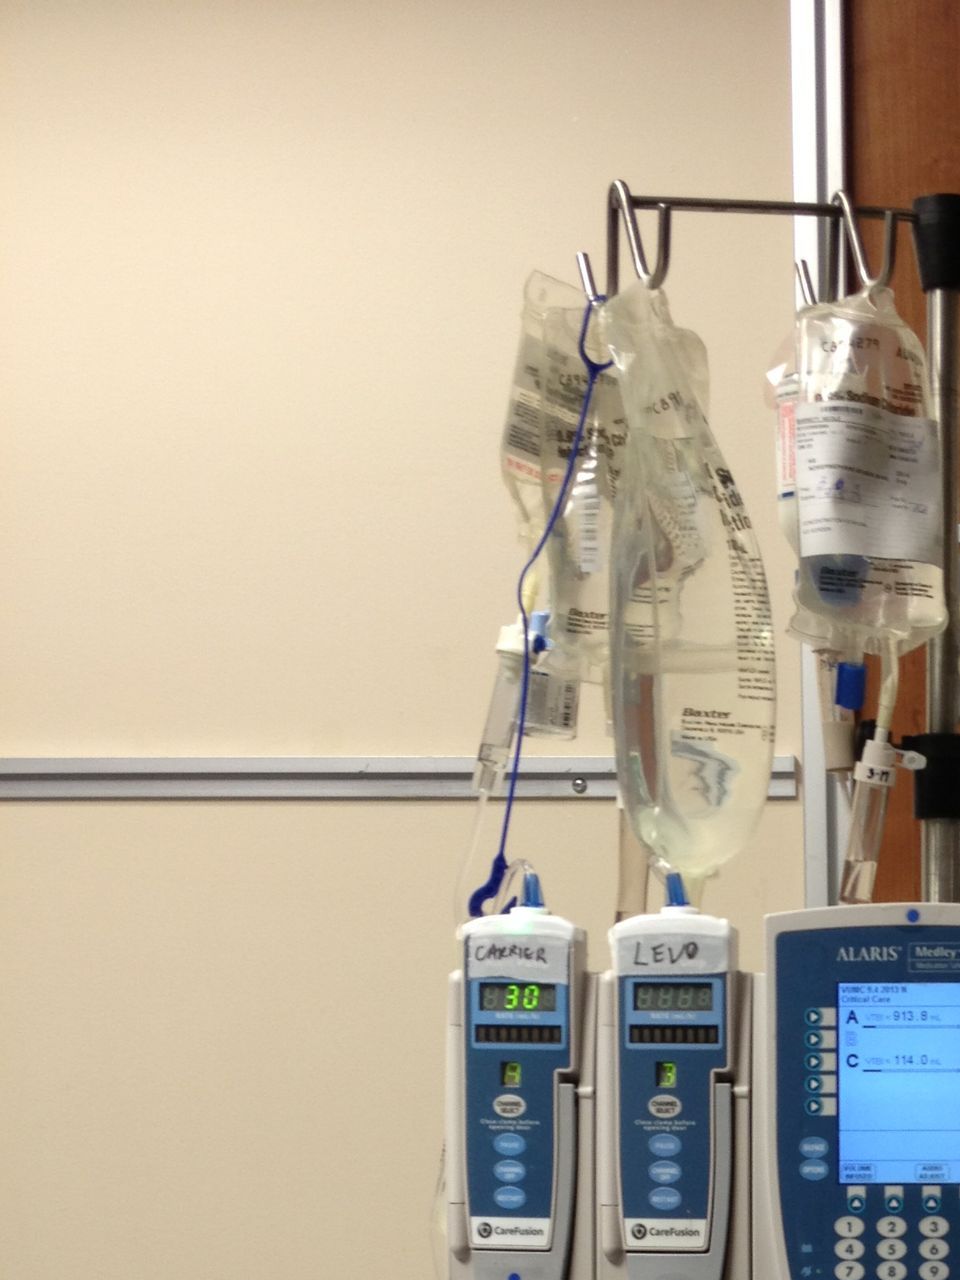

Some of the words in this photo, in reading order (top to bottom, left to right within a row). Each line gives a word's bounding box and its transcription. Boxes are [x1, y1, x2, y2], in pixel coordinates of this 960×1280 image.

[568, 608, 608, 619] Baxter
[682, 708, 732, 719] Baxter
[475, 944, 548, 964] CARRIER
[633, 941, 699, 966] LEVO
[504, 984, 540, 1010] 30
[846, 1010, 858, 1024] A
[893, 1010, 928, 1021] 913.8
[846, 1054, 859, 1068] C
[894, 1055, 929, 1065] 114.0
[495, 1226, 544, 1236] CareFusion
[649, 1227, 700, 1237] CareFusion
[887, 1222, 896, 1233] 2
[929, 1222, 938, 1233] 3
[845, 1244, 854, 1255] 4
[888, 1244, 896, 1256] 5
[930, 1244, 938, 1256] 6
[846, 1266, 854, 1278] 7
[888, 1266, 896, 1278] 8
[930, 1266, 938, 1278] 9
